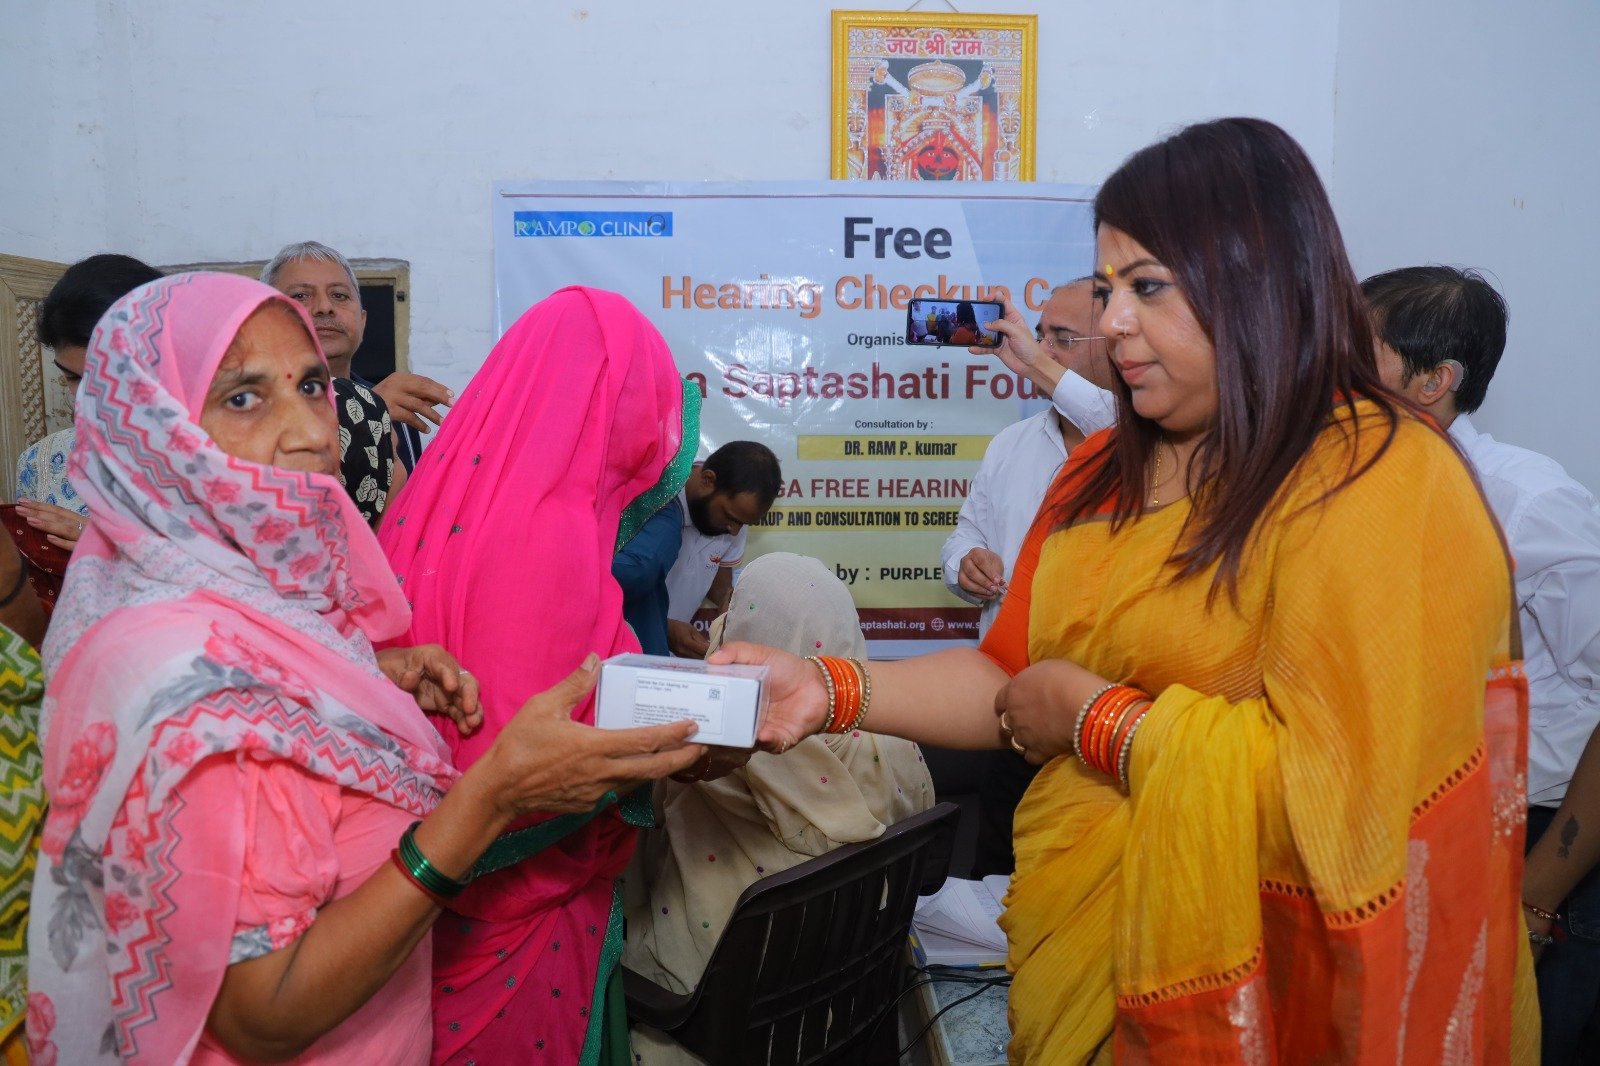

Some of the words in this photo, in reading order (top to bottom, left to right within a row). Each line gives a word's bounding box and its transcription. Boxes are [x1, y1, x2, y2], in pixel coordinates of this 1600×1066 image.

[886, 38, 919, 55] जय
[924, 33, 946, 56] श्री
[951, 39, 984, 56] राम
[600, 221, 663, 237] CLINIC
[844, 216, 953, 260] Free
[662, 273, 823, 319] Hearing
[847, 332, 905, 349] Organis
[722, 361, 950, 408] Saptashati
[966, 364, 1038, 400] Fou
[854, 419, 915, 430] Consultation
[916, 419, 928, 431] by
[844, 440, 864, 456] DR.
[867, 440, 897, 456] RAM
[899, 440, 912, 456] P.
[915, 440, 958, 456] kumar
[810, 478, 870, 498] FREE
[787, 511, 812, 526] AND
[815, 511, 901, 526] CONSULTATION
[904, 511, 919, 526] TO
[922, 511, 959, 526] SCREE
[836, 563, 859, 585] by
[880, 567, 942, 581] PURPLE
[859, 620, 926, 632] aptashati.org
[947, 621, 980, 630] www.s
